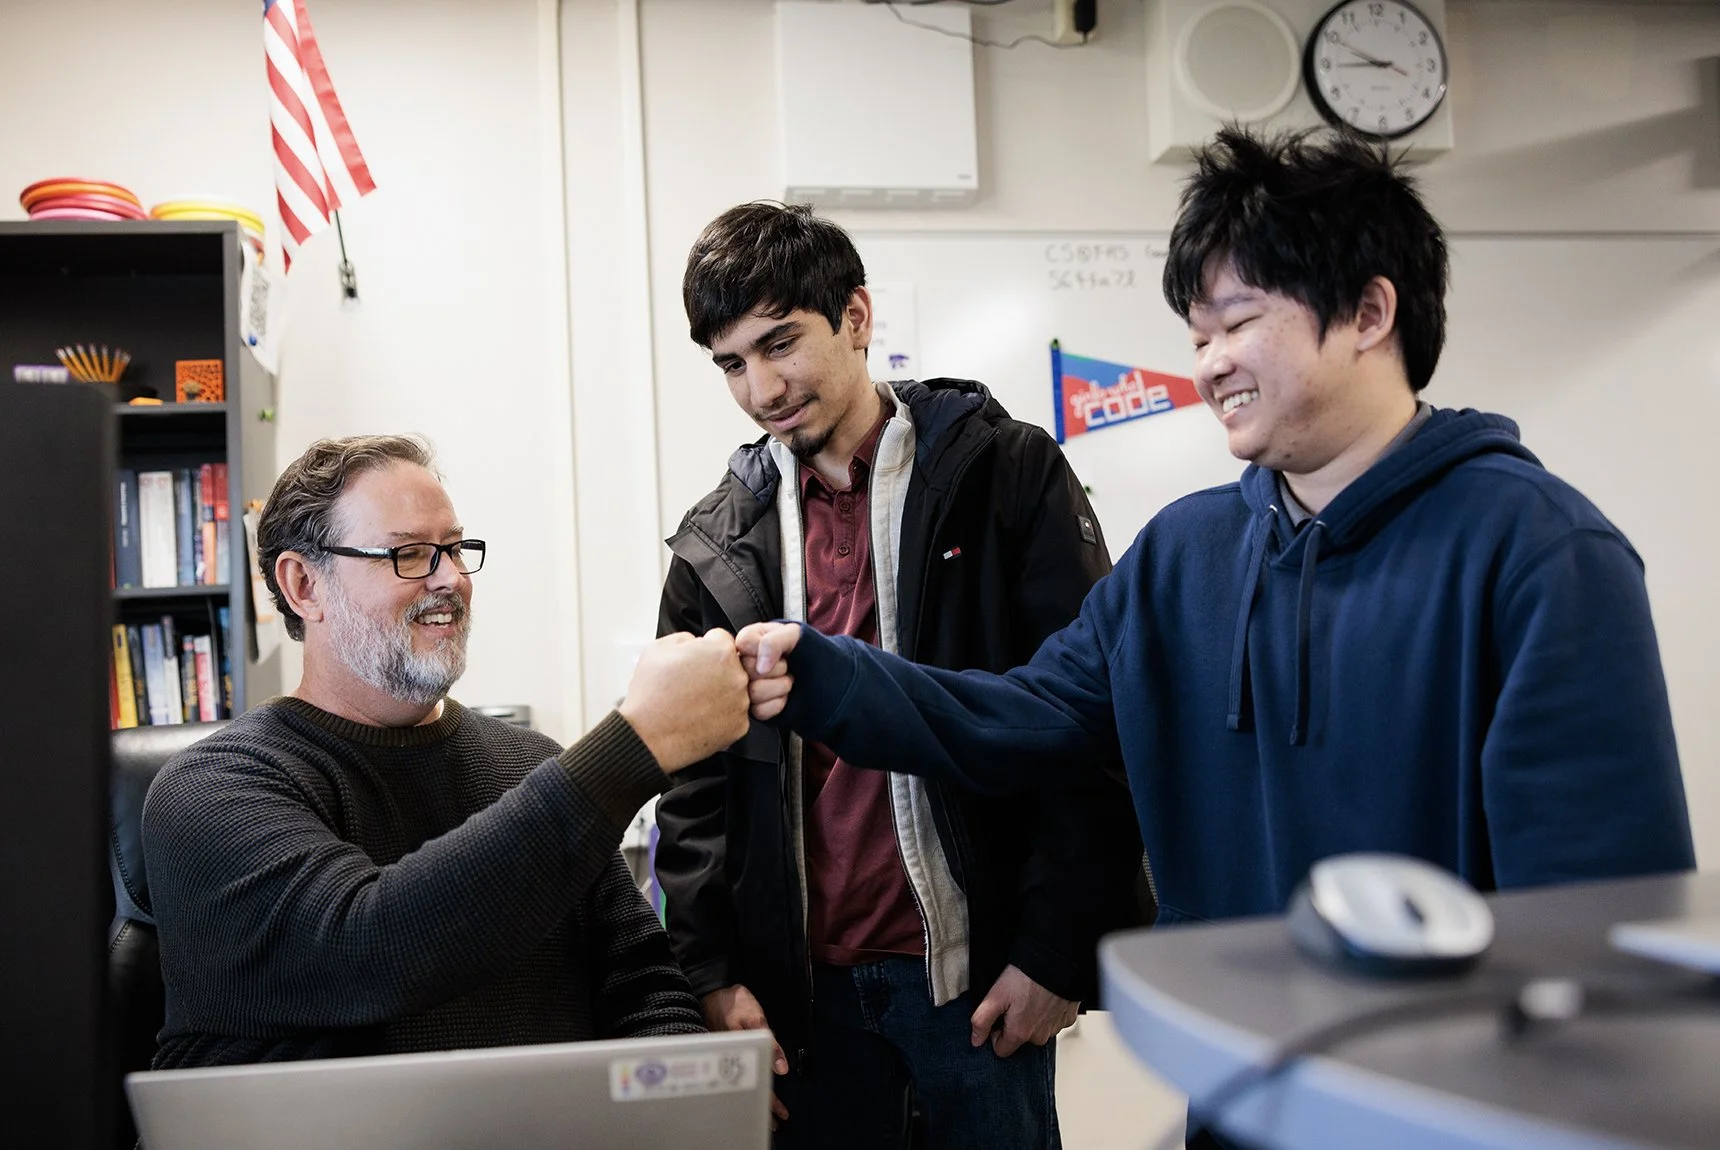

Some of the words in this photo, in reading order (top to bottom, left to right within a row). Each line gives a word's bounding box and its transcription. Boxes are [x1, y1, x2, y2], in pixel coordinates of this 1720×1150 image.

[1368, 3, 1384, 17] 12
[1341, 11, 1356, 25] 11
[1400, 11, 1406, 25] 1
[1324, 30, 1340, 44] 10
[1419, 31, 1428, 46] 2
[1320, 57, 1331, 71] 9
[1426, 58, 1436, 73] 3
[1331, 86, 1341, 100] 8
[1422, 87, 1431, 99] 4
[1352, 107, 1360, 121] 7
[1405, 108, 1415, 123] 5
[1378, 115, 1387, 130] 6
[1084, 369, 1172, 427] code
